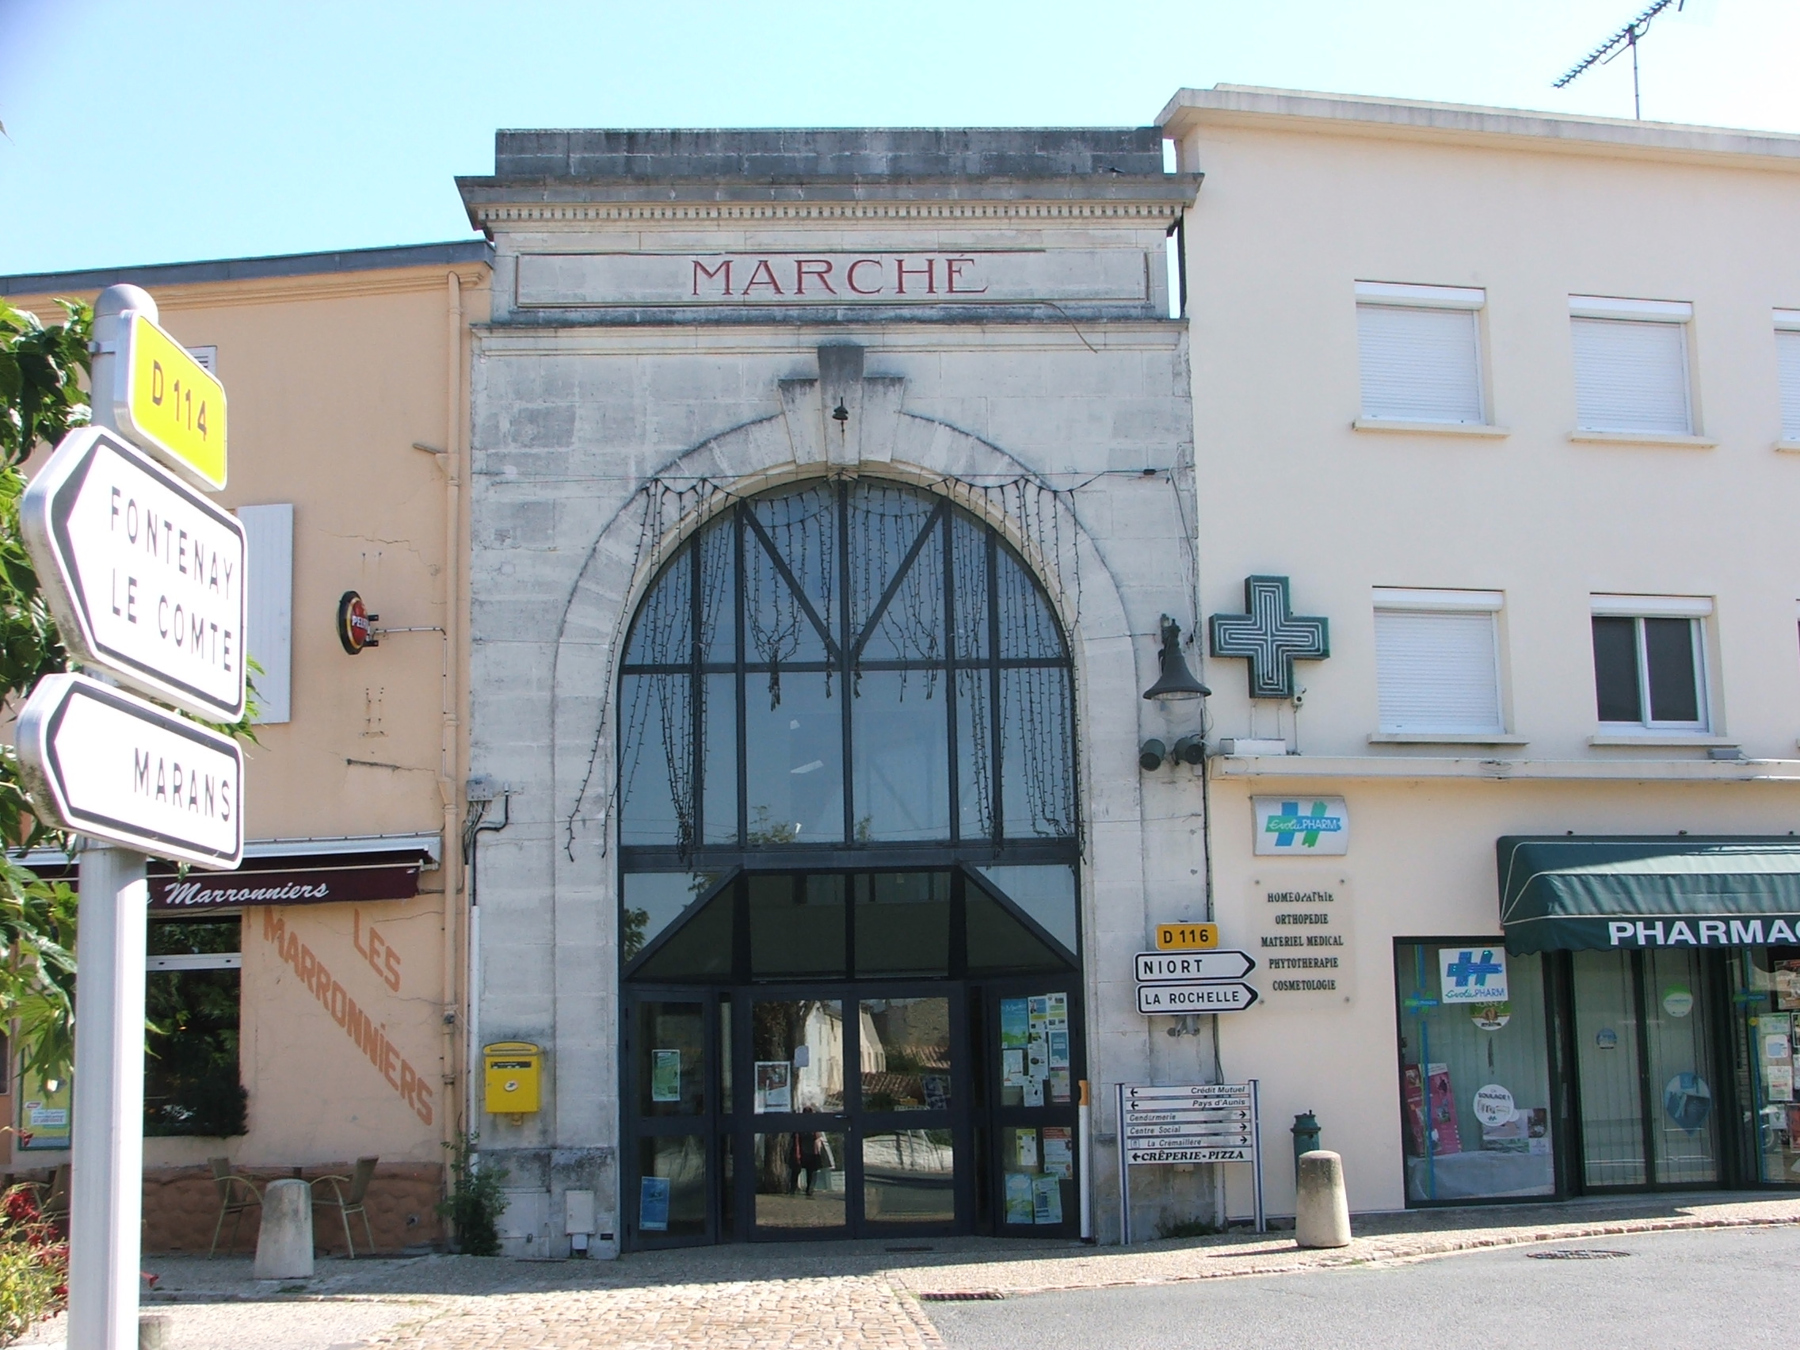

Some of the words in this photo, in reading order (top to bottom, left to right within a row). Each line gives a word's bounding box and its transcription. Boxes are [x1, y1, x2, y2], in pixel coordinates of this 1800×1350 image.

[691, 254, 989, 296] MARCHÉ
[152, 359, 164, 407] D
[174, 379, 207, 442] 114
[111, 486, 233, 600] FONTENAY
[112, 568, 137, 624] LE
[158, 595, 231, 672] COMTE
[134, 747, 230, 822] MARANS
[164, 881, 330, 905] Marronniers
[1275, 914, 1329, 925] ORTHOPEDIE
[1163, 930, 1173, 944] D
[1179, 929, 1209, 943] 116
[1608, 919, 1800, 946] PHARMA
[1261, 936, 1304, 947] MATERIEL
[1306, 935, 1344, 946] MEDICAL
[353, 908, 401, 992] LES
[1143, 959, 1203, 974] NIORT
[1269, 957, 1339, 969] PHYTOTHERAPIE
[1272, 980, 1336, 991] COSMETOLOGIE
[1145, 994, 1161, 1005] LA
[1169, 991, 1239, 1005] ROCHELLE
[1191, 1086, 1216, 1094] Crédit
[1192, 1100, 1210, 1108] Pays
[1130, 1127, 1155, 1135] Centre
